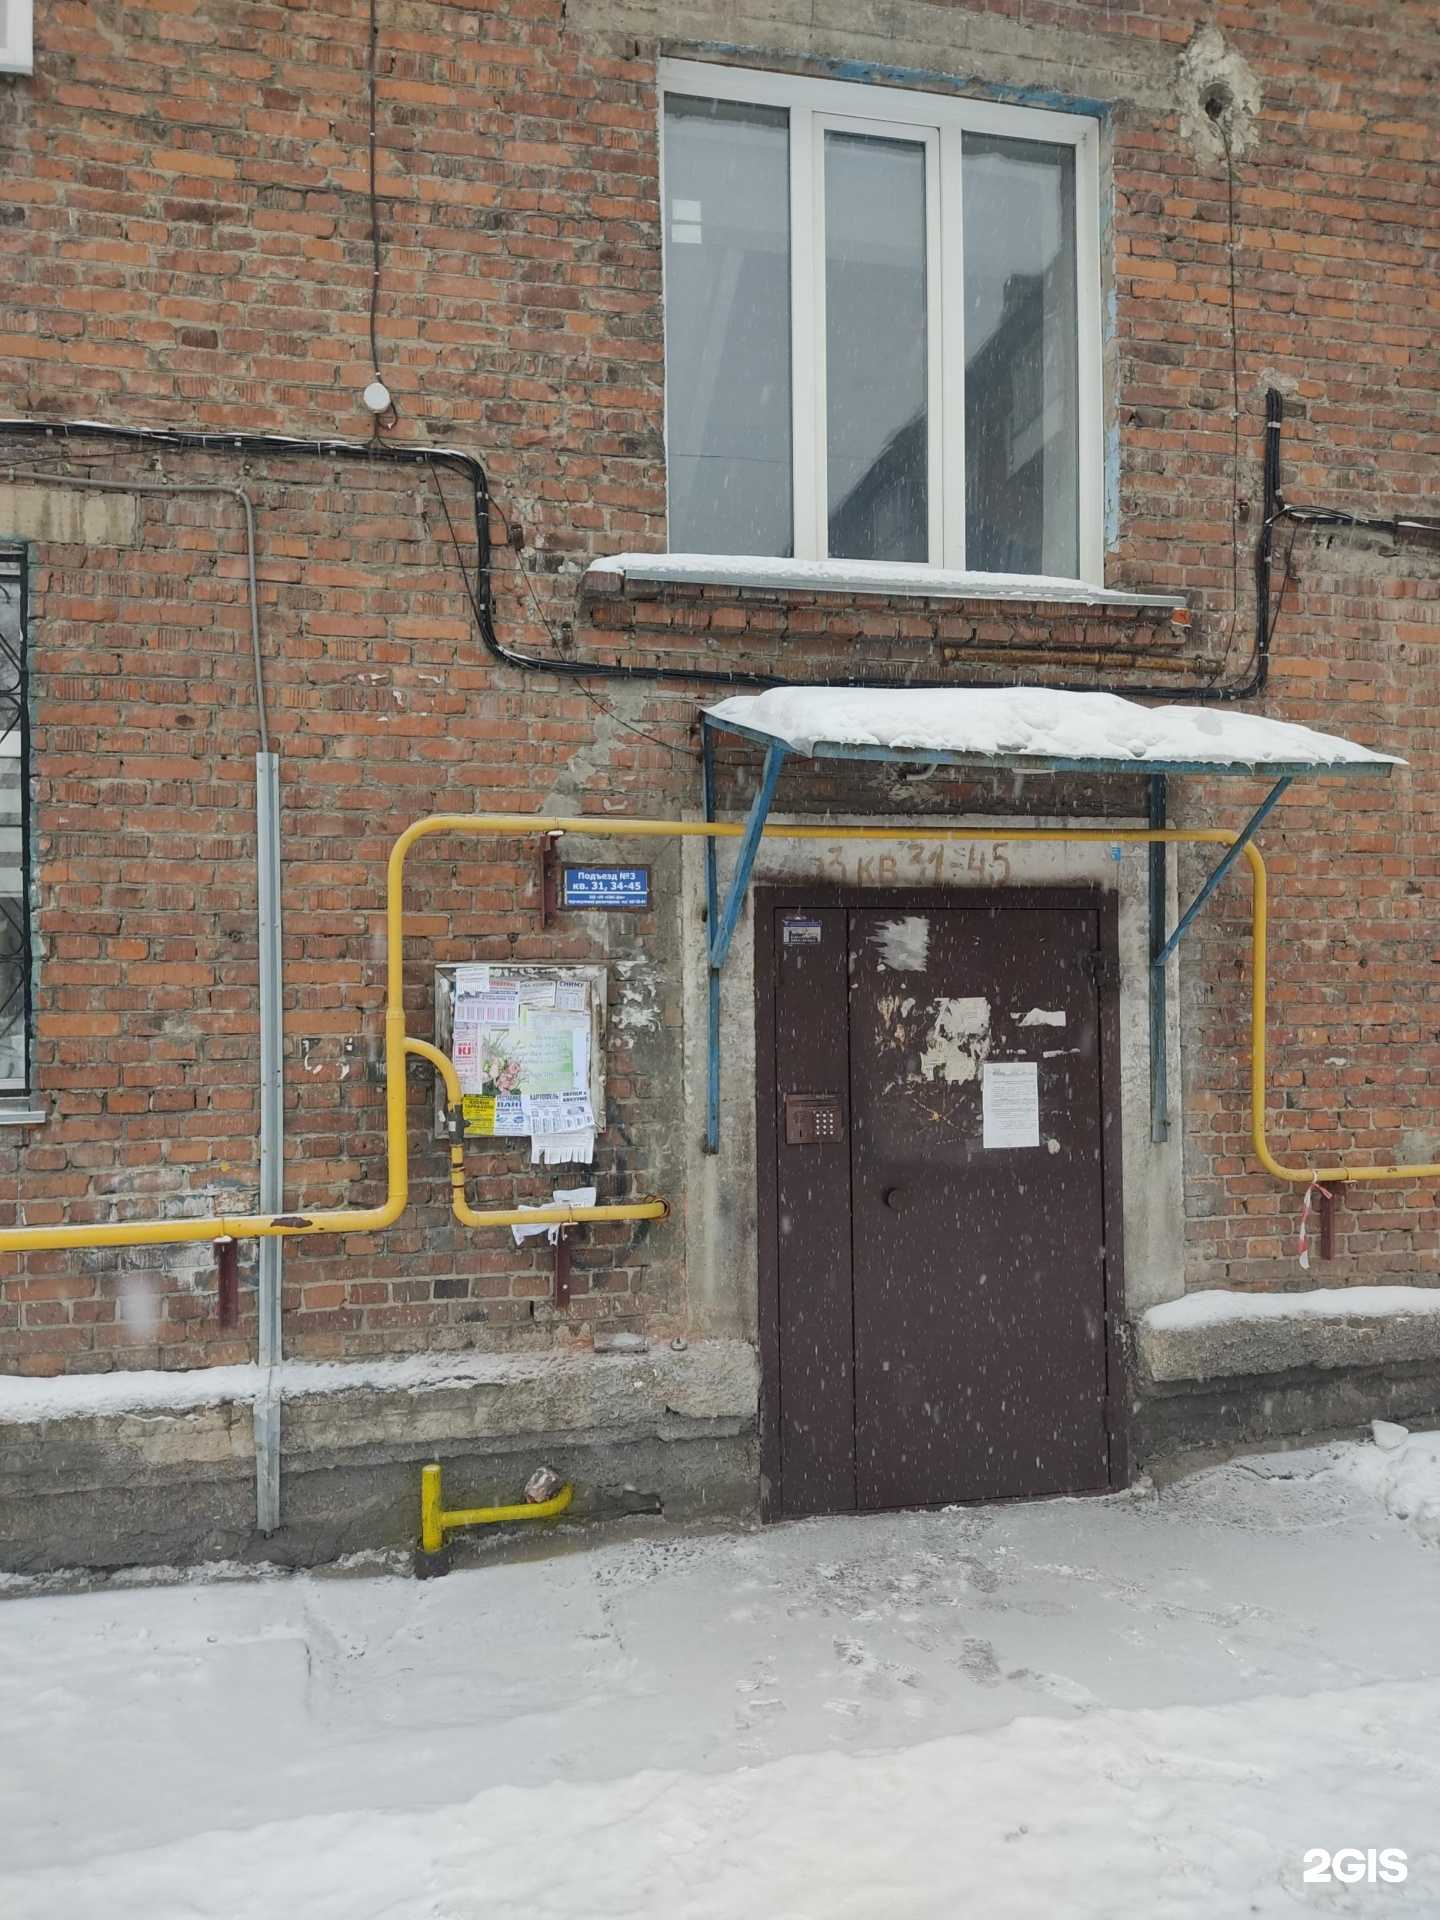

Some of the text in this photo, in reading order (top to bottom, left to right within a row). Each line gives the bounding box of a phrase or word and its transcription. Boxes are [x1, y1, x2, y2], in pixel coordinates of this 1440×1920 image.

[577, 871, 636, 881] Подъезд №3
[591, 881, 608, 892] 31,
[610, 881, 641, 891] 34-45
